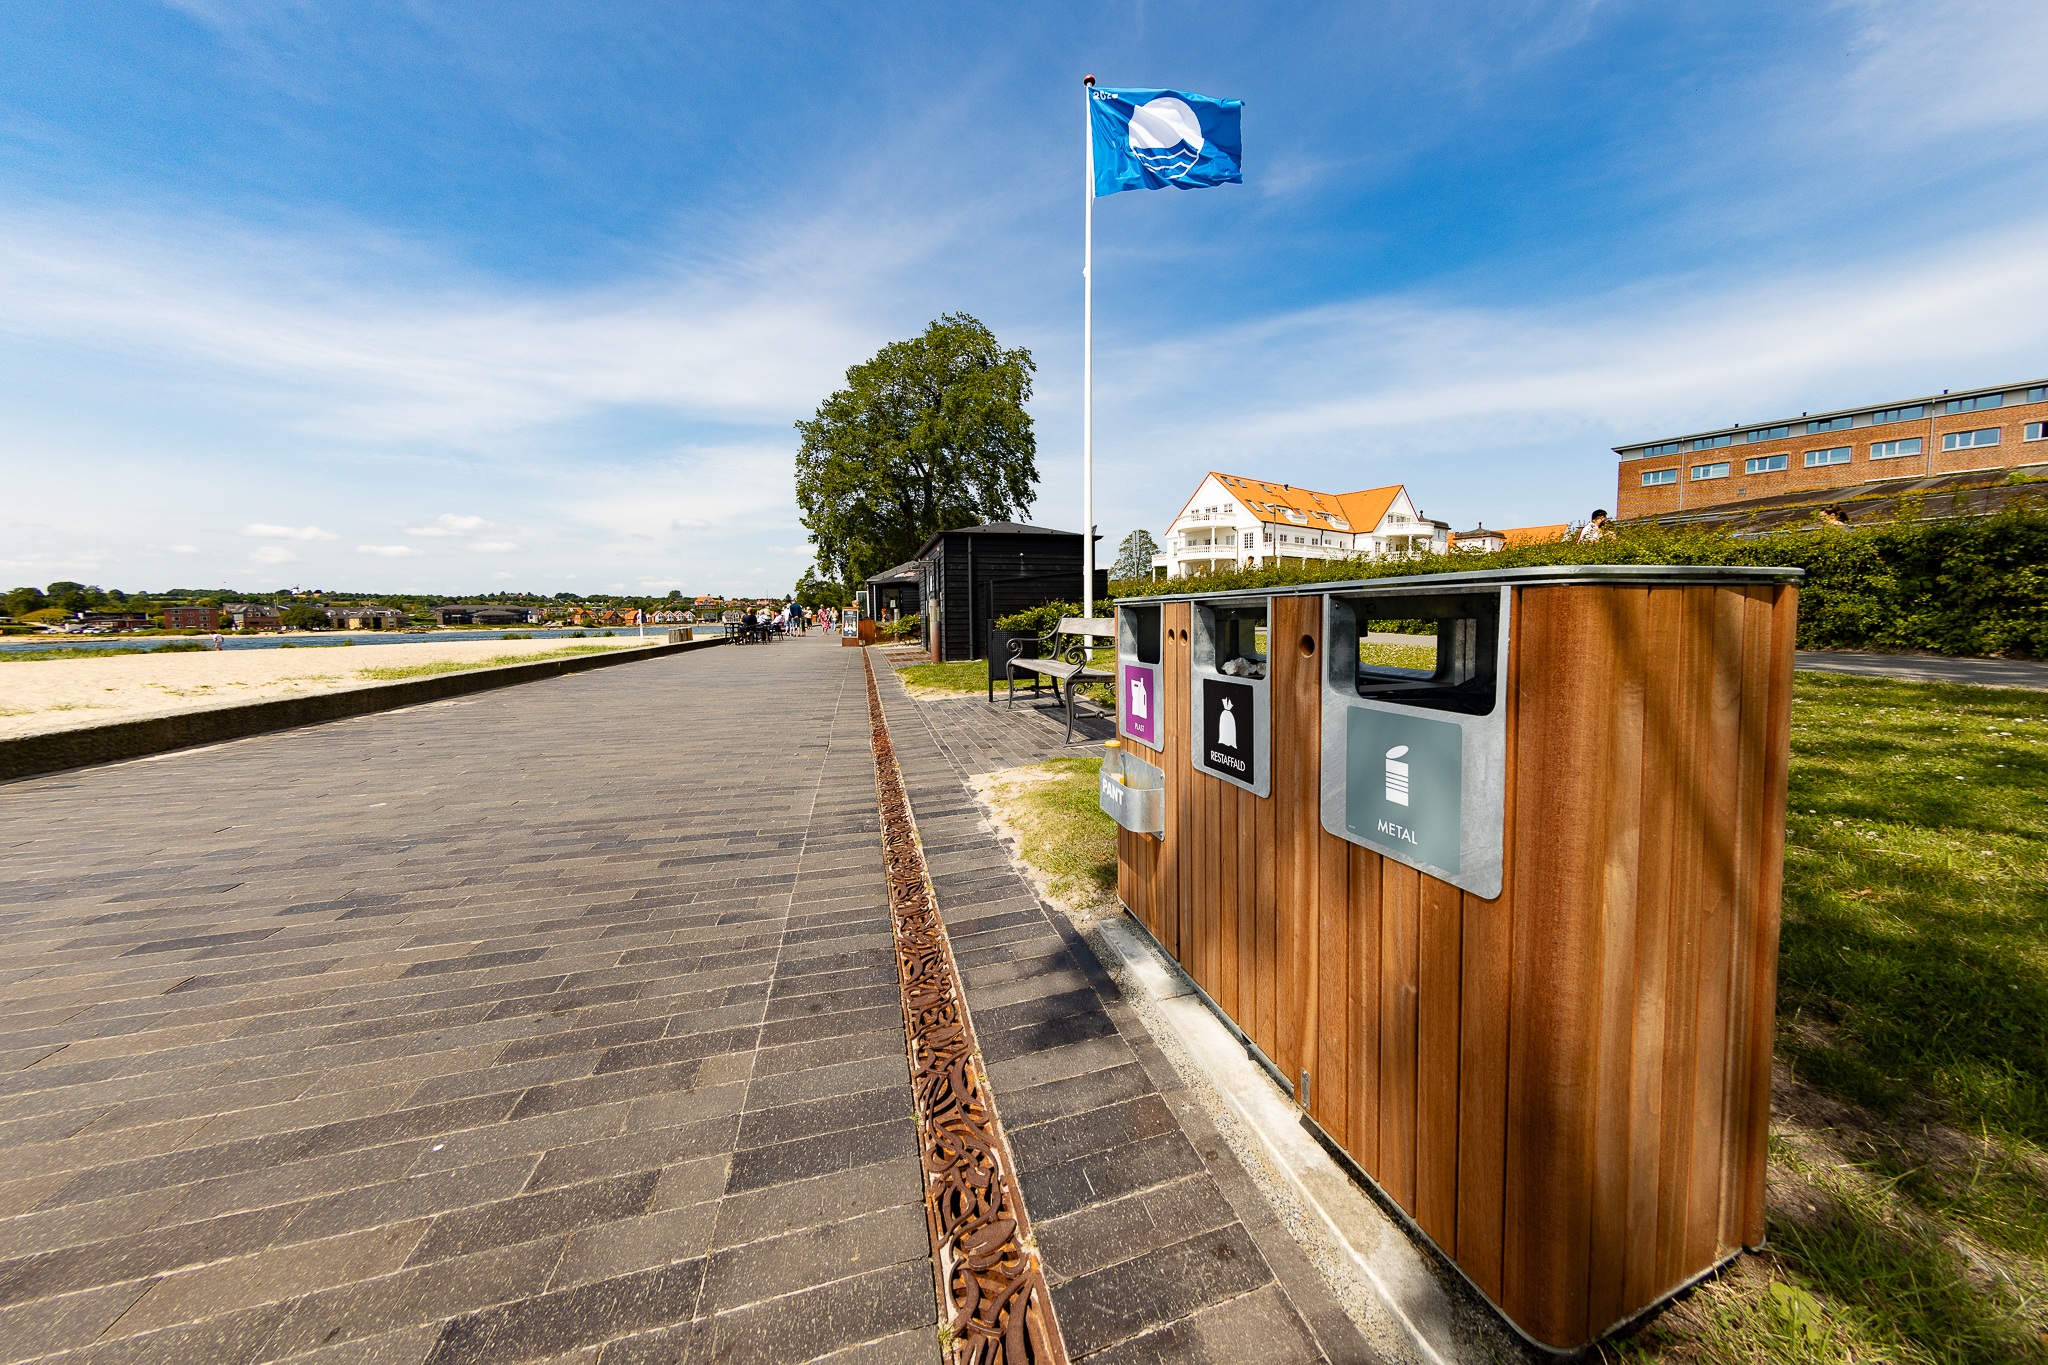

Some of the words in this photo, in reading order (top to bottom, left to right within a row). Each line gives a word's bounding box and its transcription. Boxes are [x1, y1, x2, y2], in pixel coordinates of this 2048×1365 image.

[1134, 722, 1145, 733] PLAST
[1210, 750, 1246, 772] RESTAFFALD
[1102, 777, 1124, 806] PANT
[1377, 819, 1418, 845] METAL
